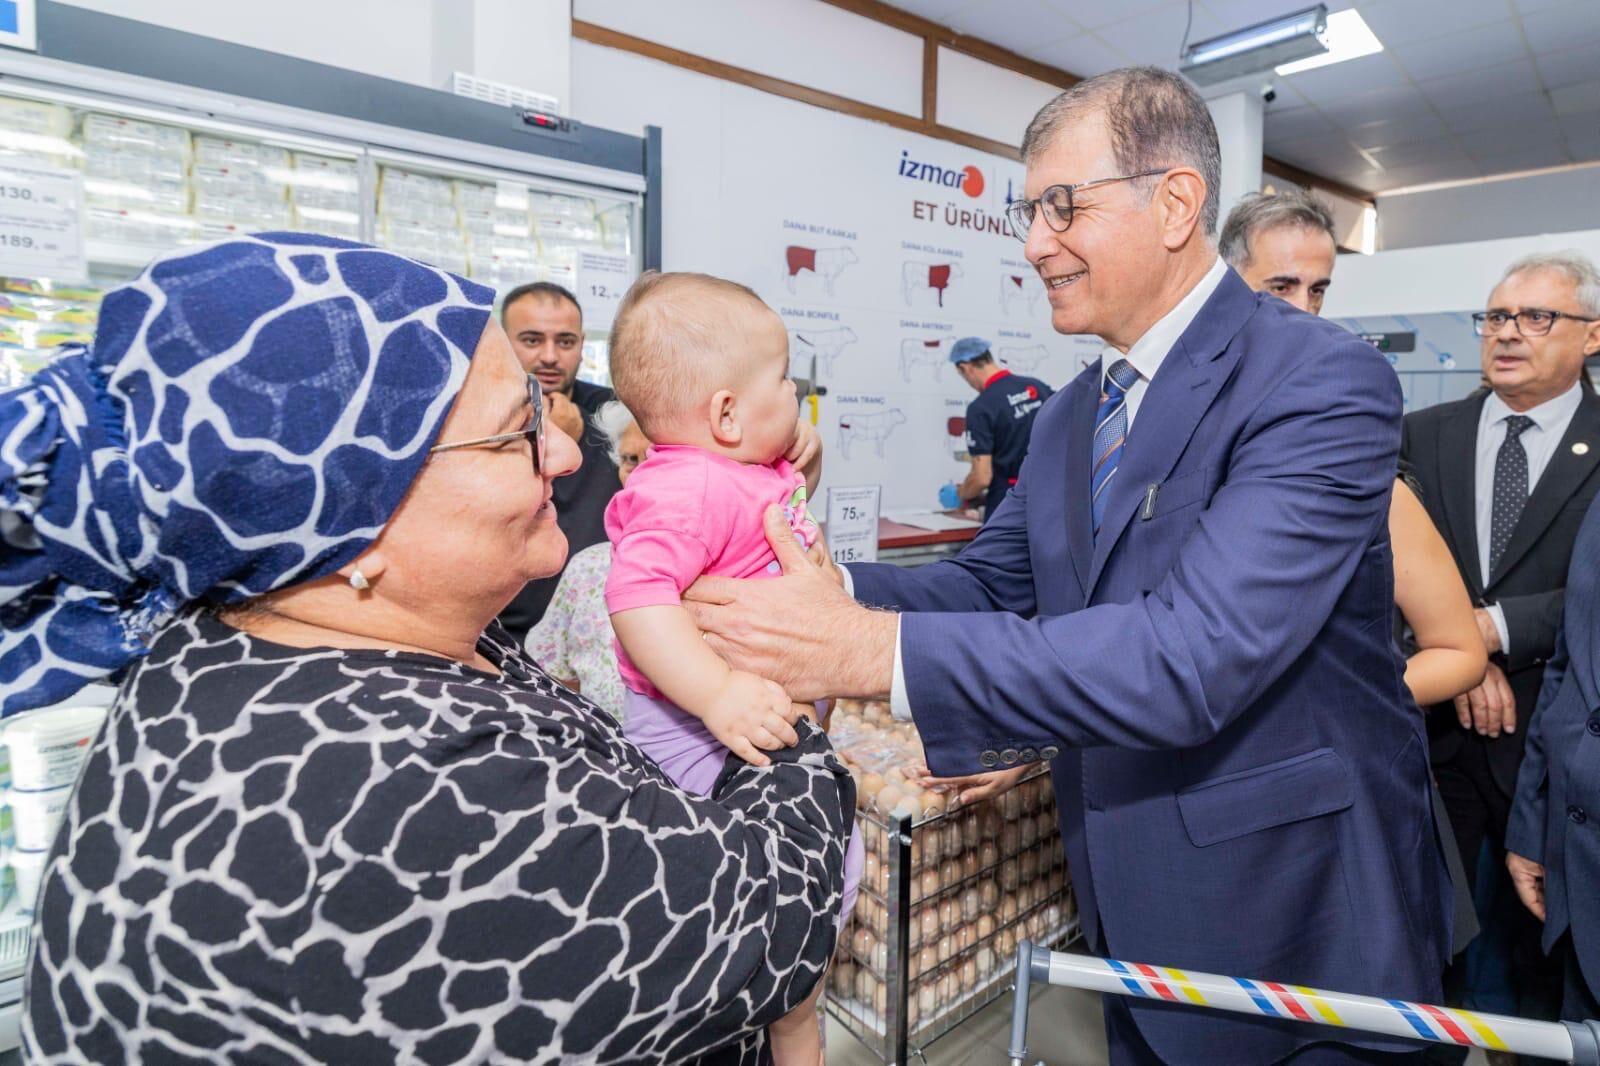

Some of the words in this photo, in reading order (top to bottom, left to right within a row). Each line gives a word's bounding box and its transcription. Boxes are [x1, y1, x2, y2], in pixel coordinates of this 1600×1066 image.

[898, 150, 967, 189] izmar
[913, 200, 938, 222] ET
[945, 202, 1013, 238] ÜRÜNL
